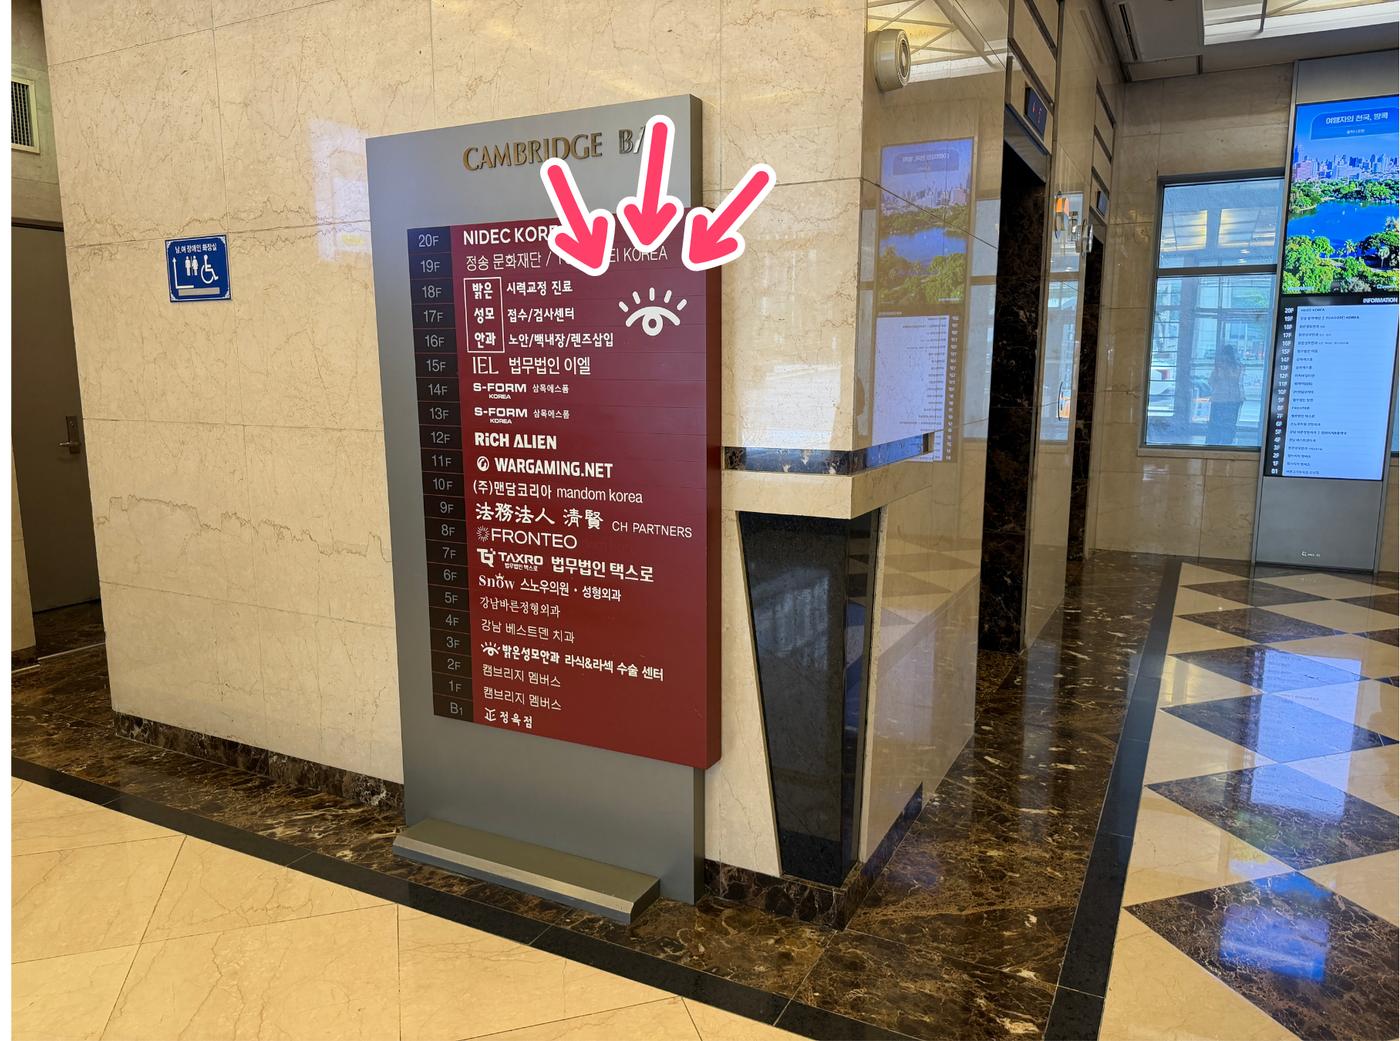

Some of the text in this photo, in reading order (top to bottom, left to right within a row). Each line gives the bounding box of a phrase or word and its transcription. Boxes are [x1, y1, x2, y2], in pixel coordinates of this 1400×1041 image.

[462, 132, 603, 172] CAMBRIDGE
[418, 233, 440, 248] 20F
[463, 228, 511, 246] NIDEC
[420, 259, 441, 273] 19F
[466, 254, 489, 272] 정송
[493, 252, 541, 270] 문화재단
[623, 246, 668, 262] KOREA
[422, 280, 574, 299] 18F 밝은 시력교정 진료
[423, 307, 575, 324] 17F 성모 접수/검사센터
[424, 332, 614, 348] 16F 안과 노안/백내장/렌즈삽입
[426, 356, 591, 375] 15F IEL 법무법인 이엘
[428, 383, 448, 396] 14F
[473, 383, 527, 393] S-FORM
[429, 407, 449, 420] 13F
[474, 407, 528, 418] S-FORM
[430, 431, 451, 444] 12F
[513, 433, 557, 450] ALIEN
[431, 454, 613, 479] 11F WARGAMING.NET
[432, 478, 643, 504] 10F (주)맨담코리아 mandom korea
[439, 501, 454, 514] 9F
[475, 501, 556, 525] 法務法人
[611, 520, 628, 533] CH
[632, 522, 693, 538] PARTNERS
[441, 523, 578, 549] 8F FRONTEO
[442, 546, 654, 583] 7F TAXRO 법무법인 택스로
[443, 568, 458, 582] 6F
[520, 578, 569, 597] 스노우의원
[582, 585, 621, 602] 성형외과
[444, 591, 560, 618] 5F 강남바른정형외과
[445, 613, 575, 644] 4F 강남 베스트덴 치과
[446, 636, 664, 682] 3F 밝은성모안과 라식&라섹 수술 센터
[447, 658, 561, 688] 2F 캠브리지 멤버스
[448, 680, 562, 711] 1F 캠브리지 멤버스
[450, 702, 463, 716] B1
